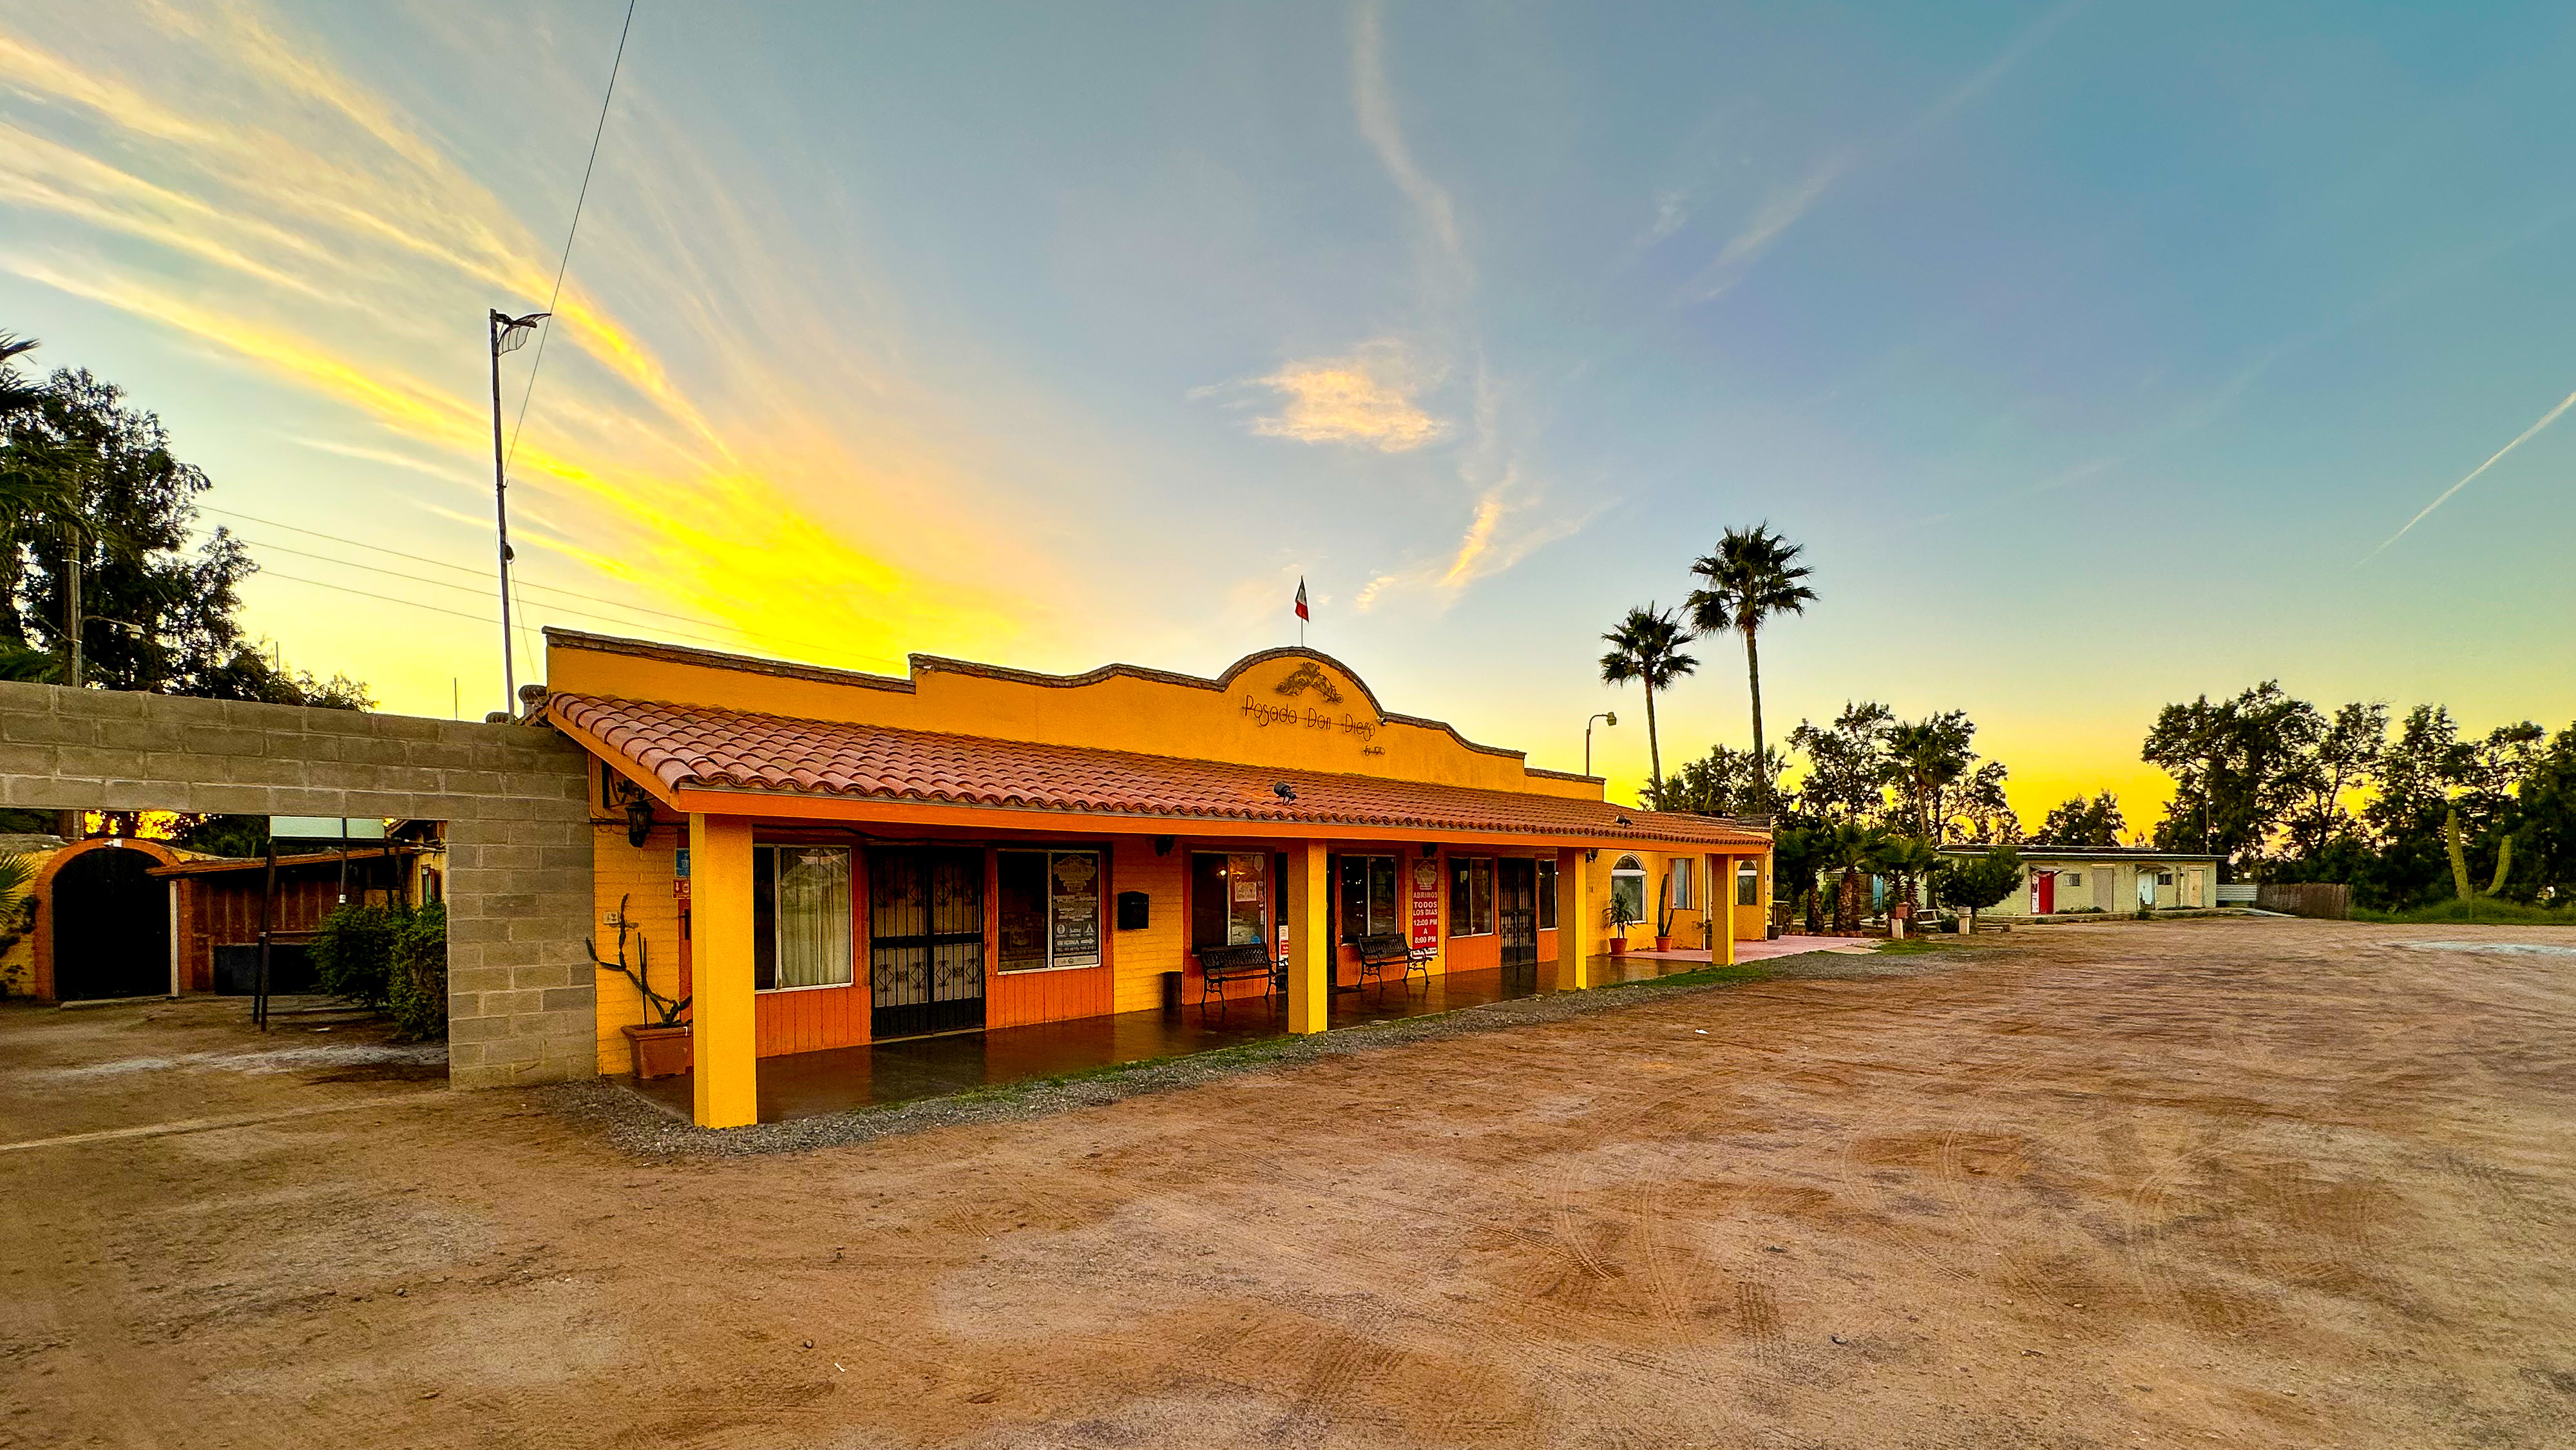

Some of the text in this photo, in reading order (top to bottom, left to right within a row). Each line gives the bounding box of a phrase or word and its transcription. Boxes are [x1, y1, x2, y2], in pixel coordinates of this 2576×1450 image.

[1245, 694, 1376, 741] Posada Don Diego
